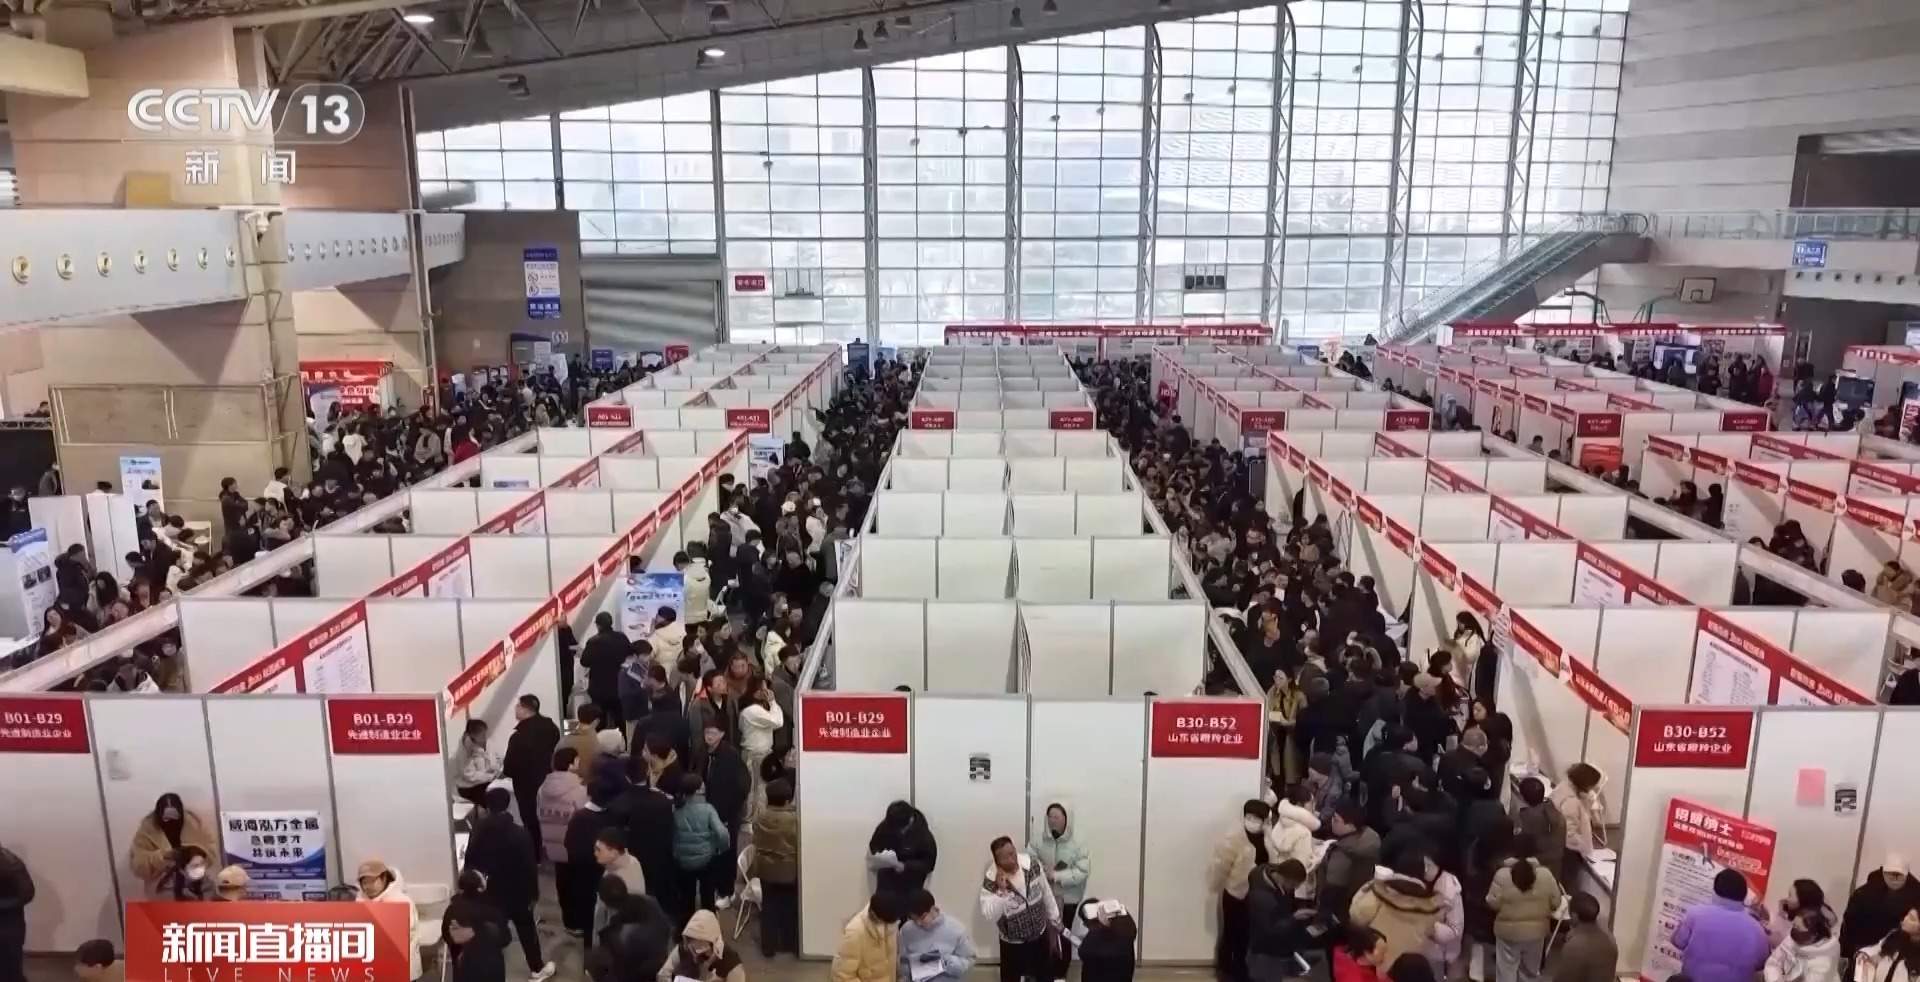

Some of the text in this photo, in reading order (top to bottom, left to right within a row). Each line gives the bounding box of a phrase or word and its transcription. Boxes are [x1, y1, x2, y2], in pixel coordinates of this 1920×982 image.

[4, 711, 63, 724] B01-B29
[353, 713, 413, 726] B01-B29
[825, 711, 885, 724] B01-B29
[1176, 717, 1237, 730] B30-B52
[1663, 725, 1727, 738] B30-B52
